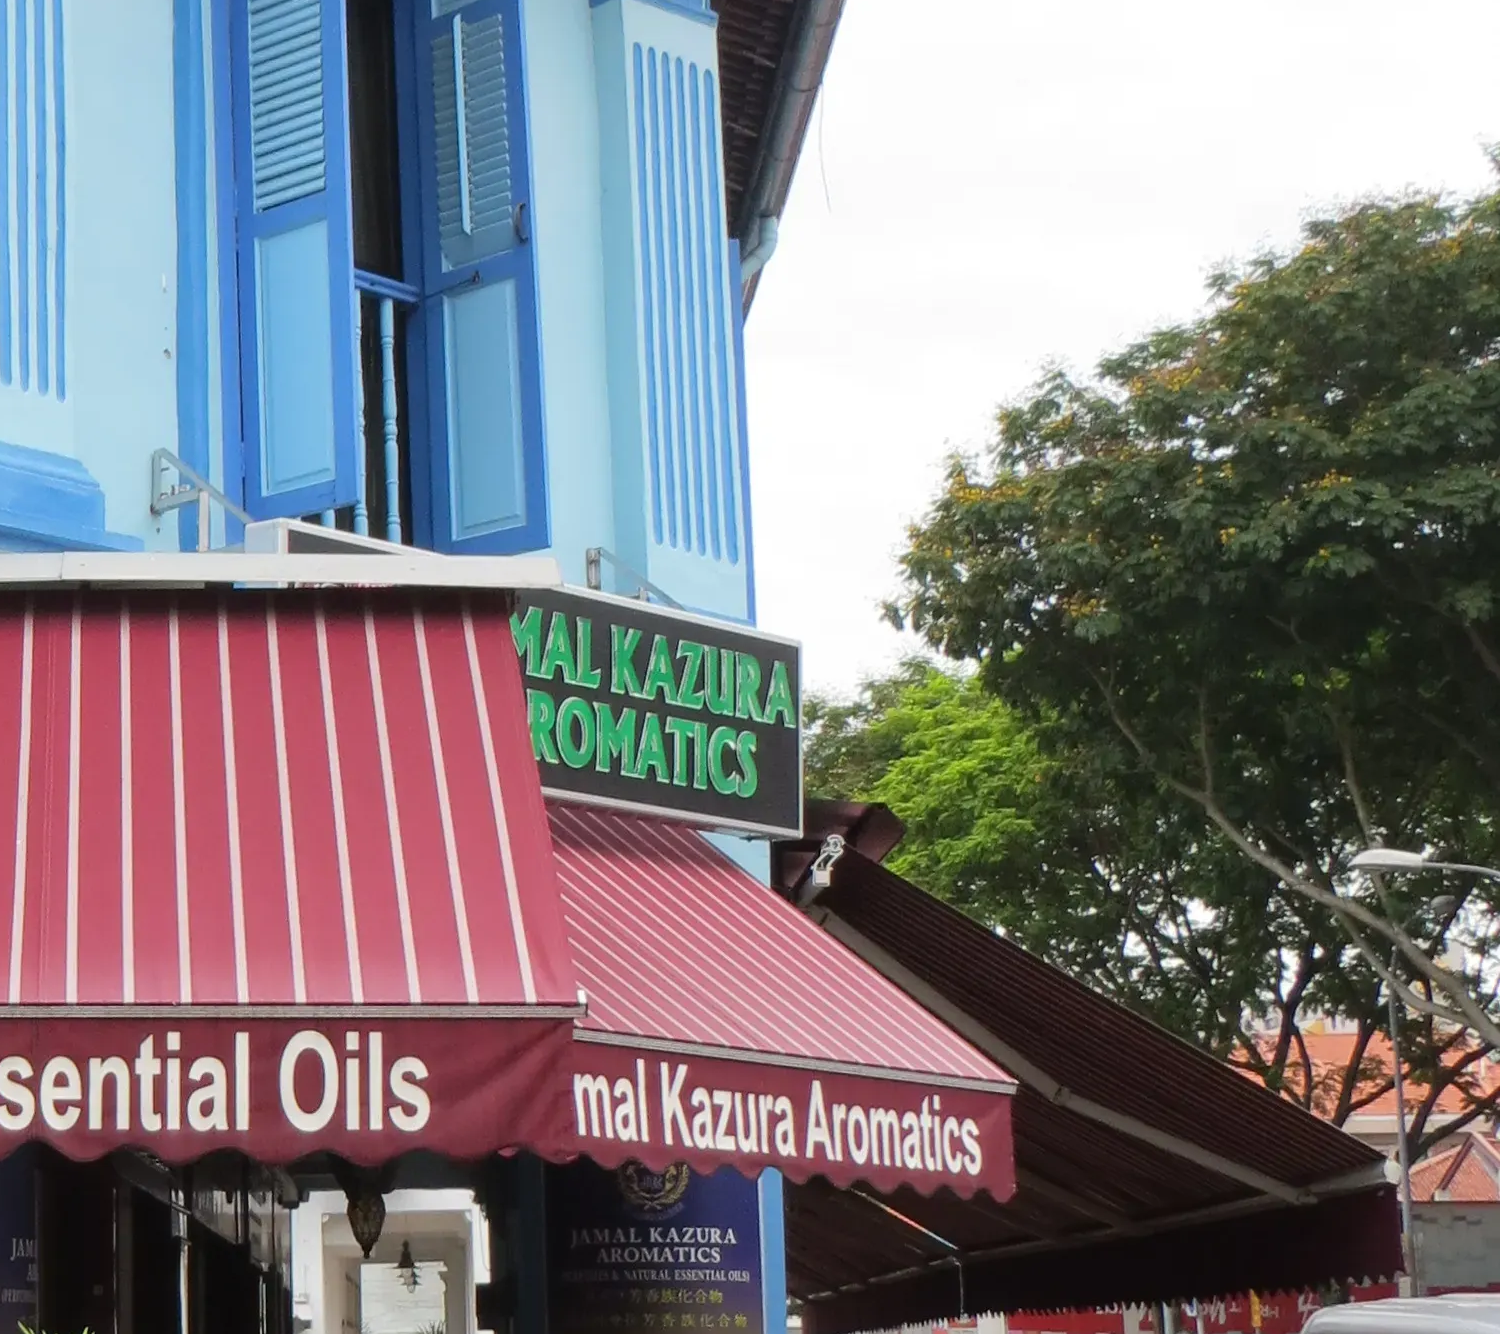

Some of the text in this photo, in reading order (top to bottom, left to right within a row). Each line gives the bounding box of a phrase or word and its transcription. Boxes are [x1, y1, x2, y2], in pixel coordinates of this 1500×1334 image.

[509, 606, 797, 729] MAL KAZURA
[526, 688, 758, 799] ROMATICS
[279, 1029, 431, 1133] Oils
[573, 1058, 983, 1176] mal Kazura Aromatics
[570, 1226, 738, 1249] JAMAL KAZURA
[596, 1246, 722, 1264] AROMATICS
[623, 1269, 671, 1283] NATURAL
[674, 1269, 727, 1283] ESSENTIAL
